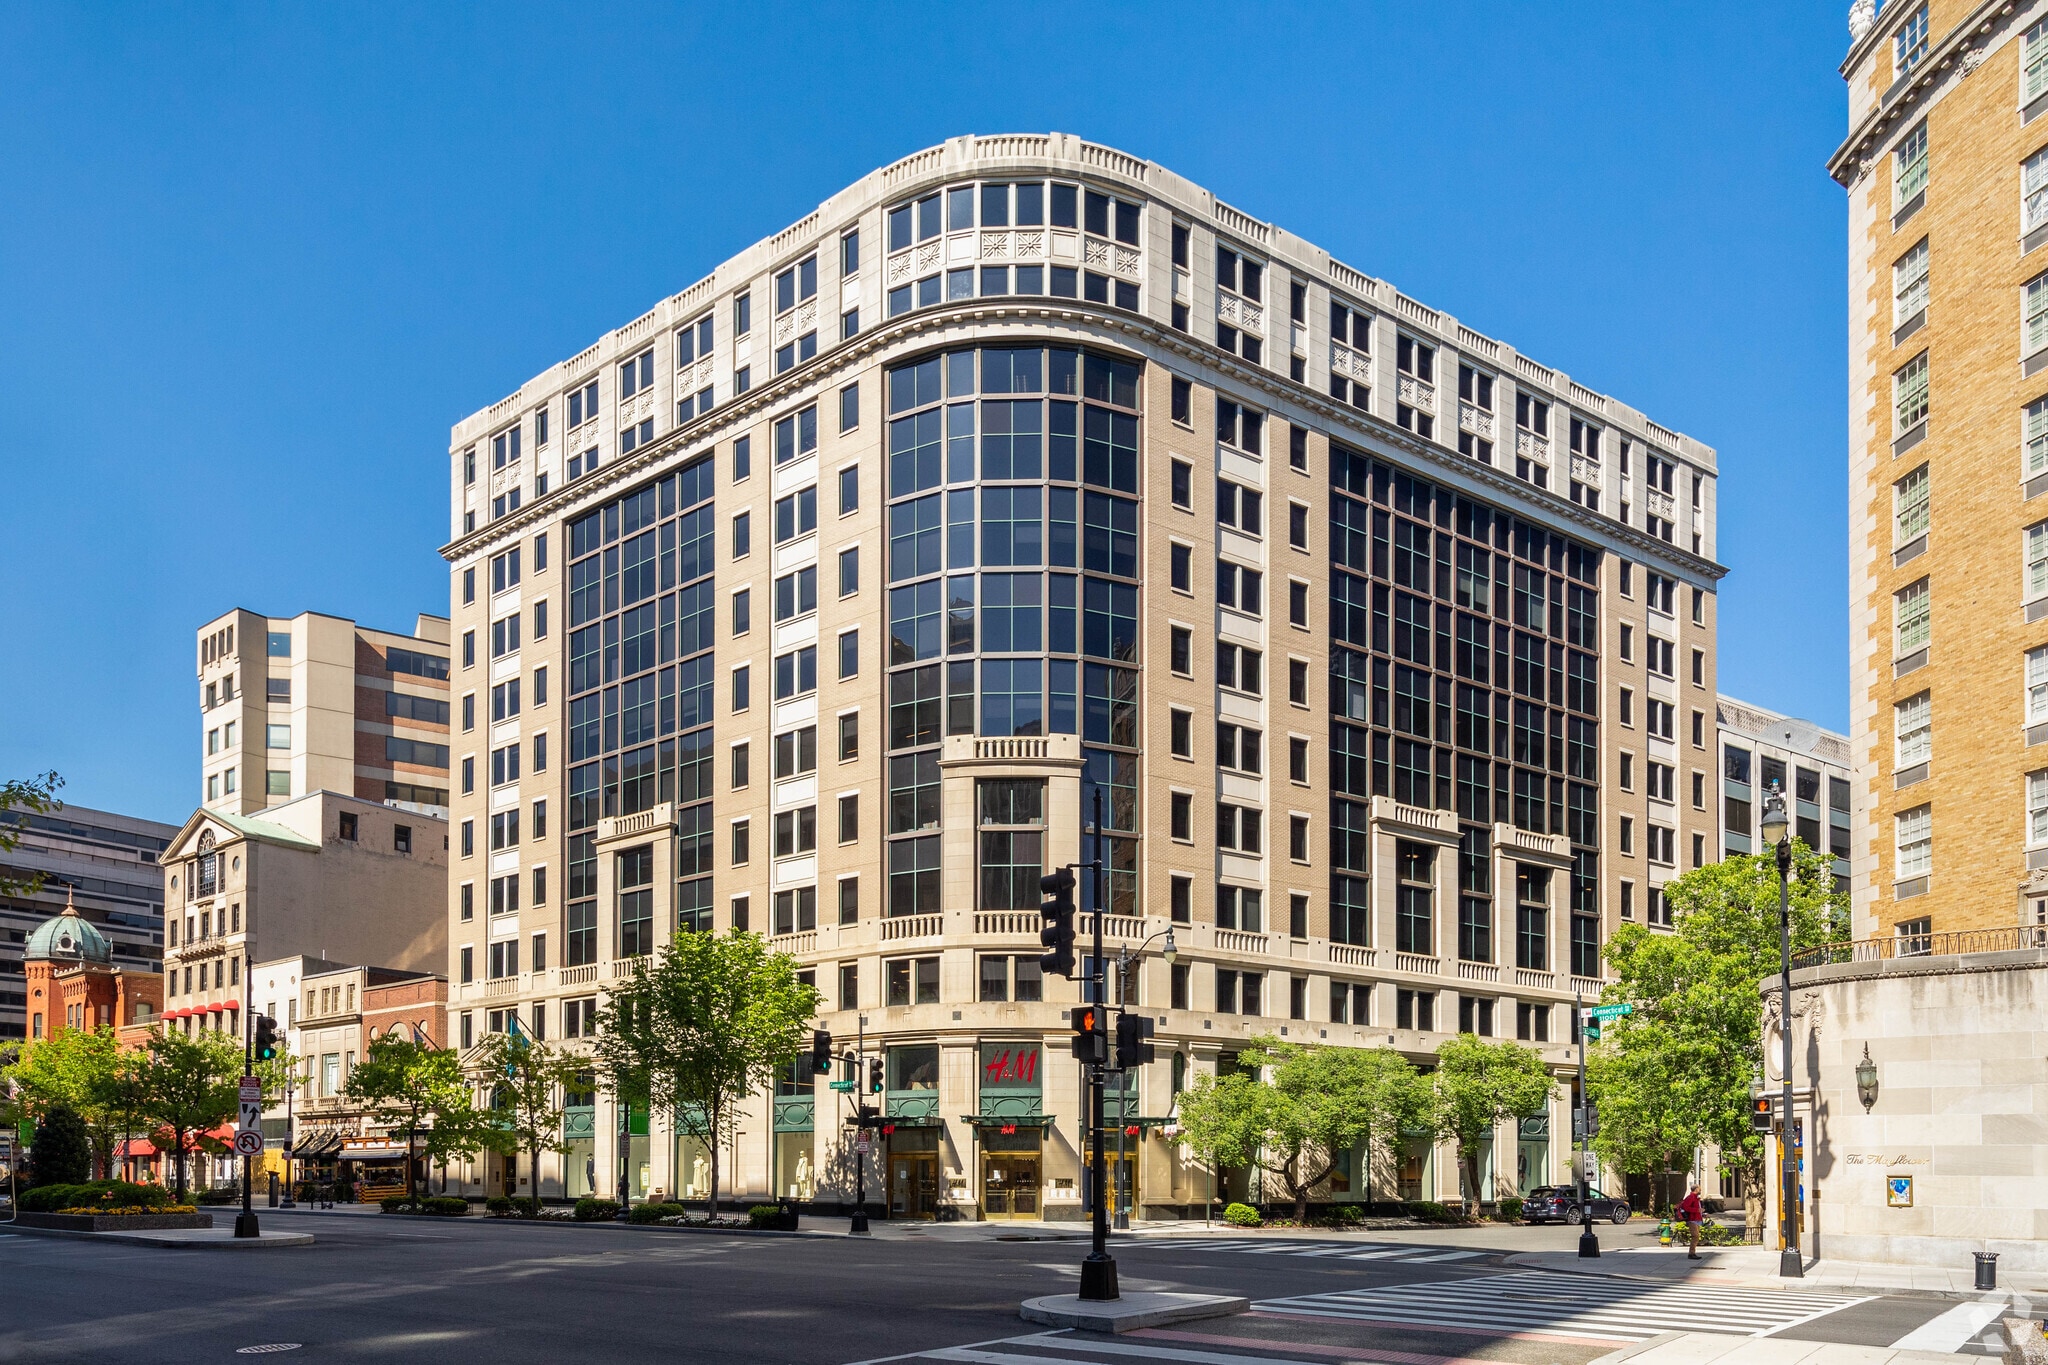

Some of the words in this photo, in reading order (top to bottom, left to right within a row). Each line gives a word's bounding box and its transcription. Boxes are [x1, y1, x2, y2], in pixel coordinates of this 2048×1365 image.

[1593, 1006, 1624, 1016] Connecticut
[1846, 1153, 1864, 1165] The
[1867, 1154, 1930, 1167] Mayflower
